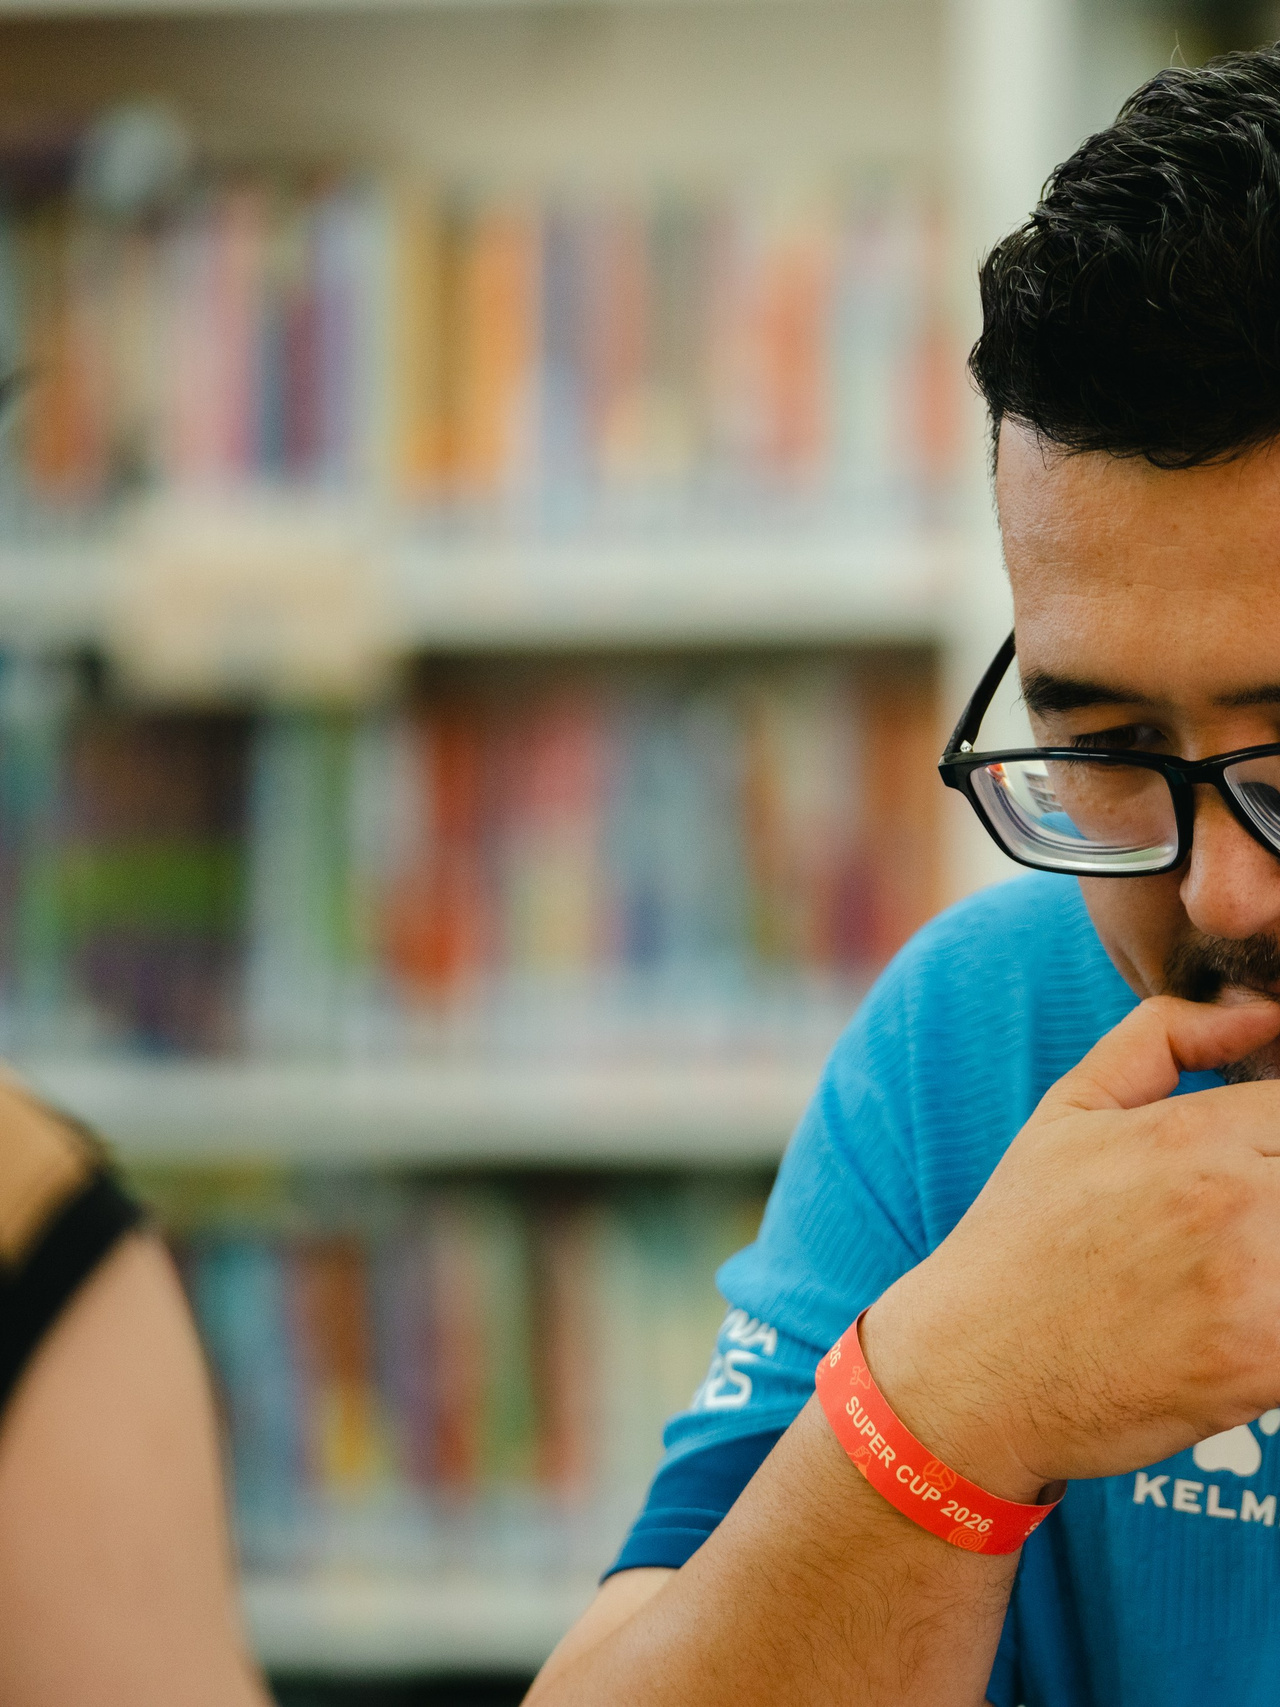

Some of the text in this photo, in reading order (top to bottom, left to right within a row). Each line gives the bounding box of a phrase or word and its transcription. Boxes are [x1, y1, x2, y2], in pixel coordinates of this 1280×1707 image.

[845, 1396, 993, 1533] SUPER CUP 2026
